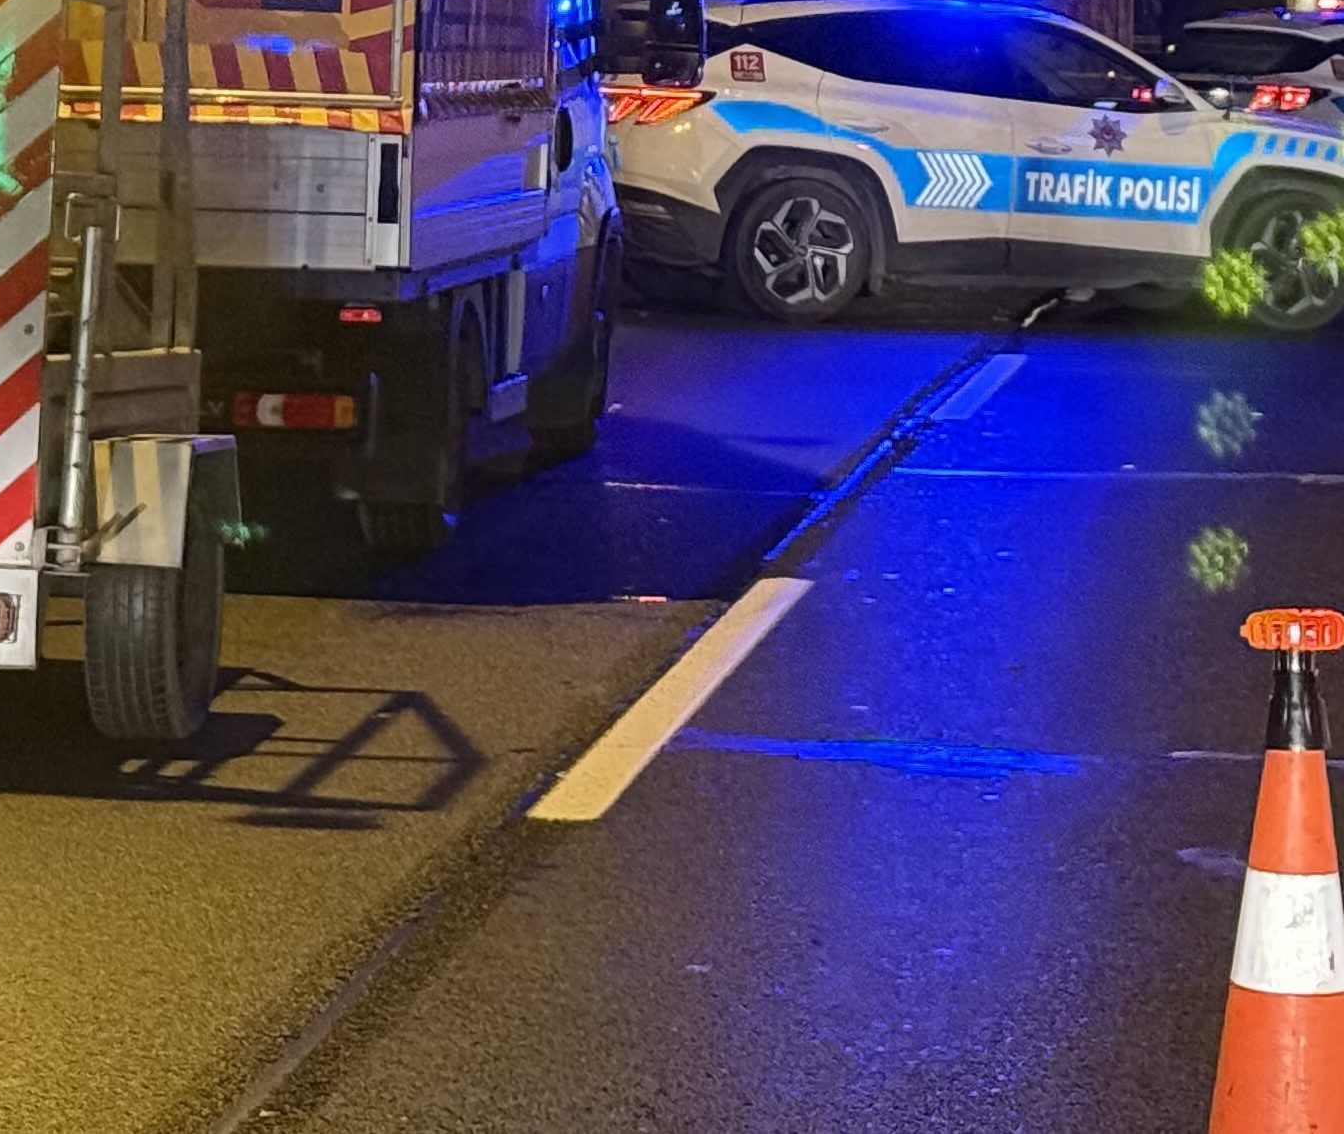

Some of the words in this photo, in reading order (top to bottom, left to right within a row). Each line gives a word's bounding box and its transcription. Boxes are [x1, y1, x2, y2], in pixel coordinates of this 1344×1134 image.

[733, 54, 760, 71] 112
[1025, 169, 1113, 207] TRAFİK
[1118, 174, 1201, 214] POLİSİ
